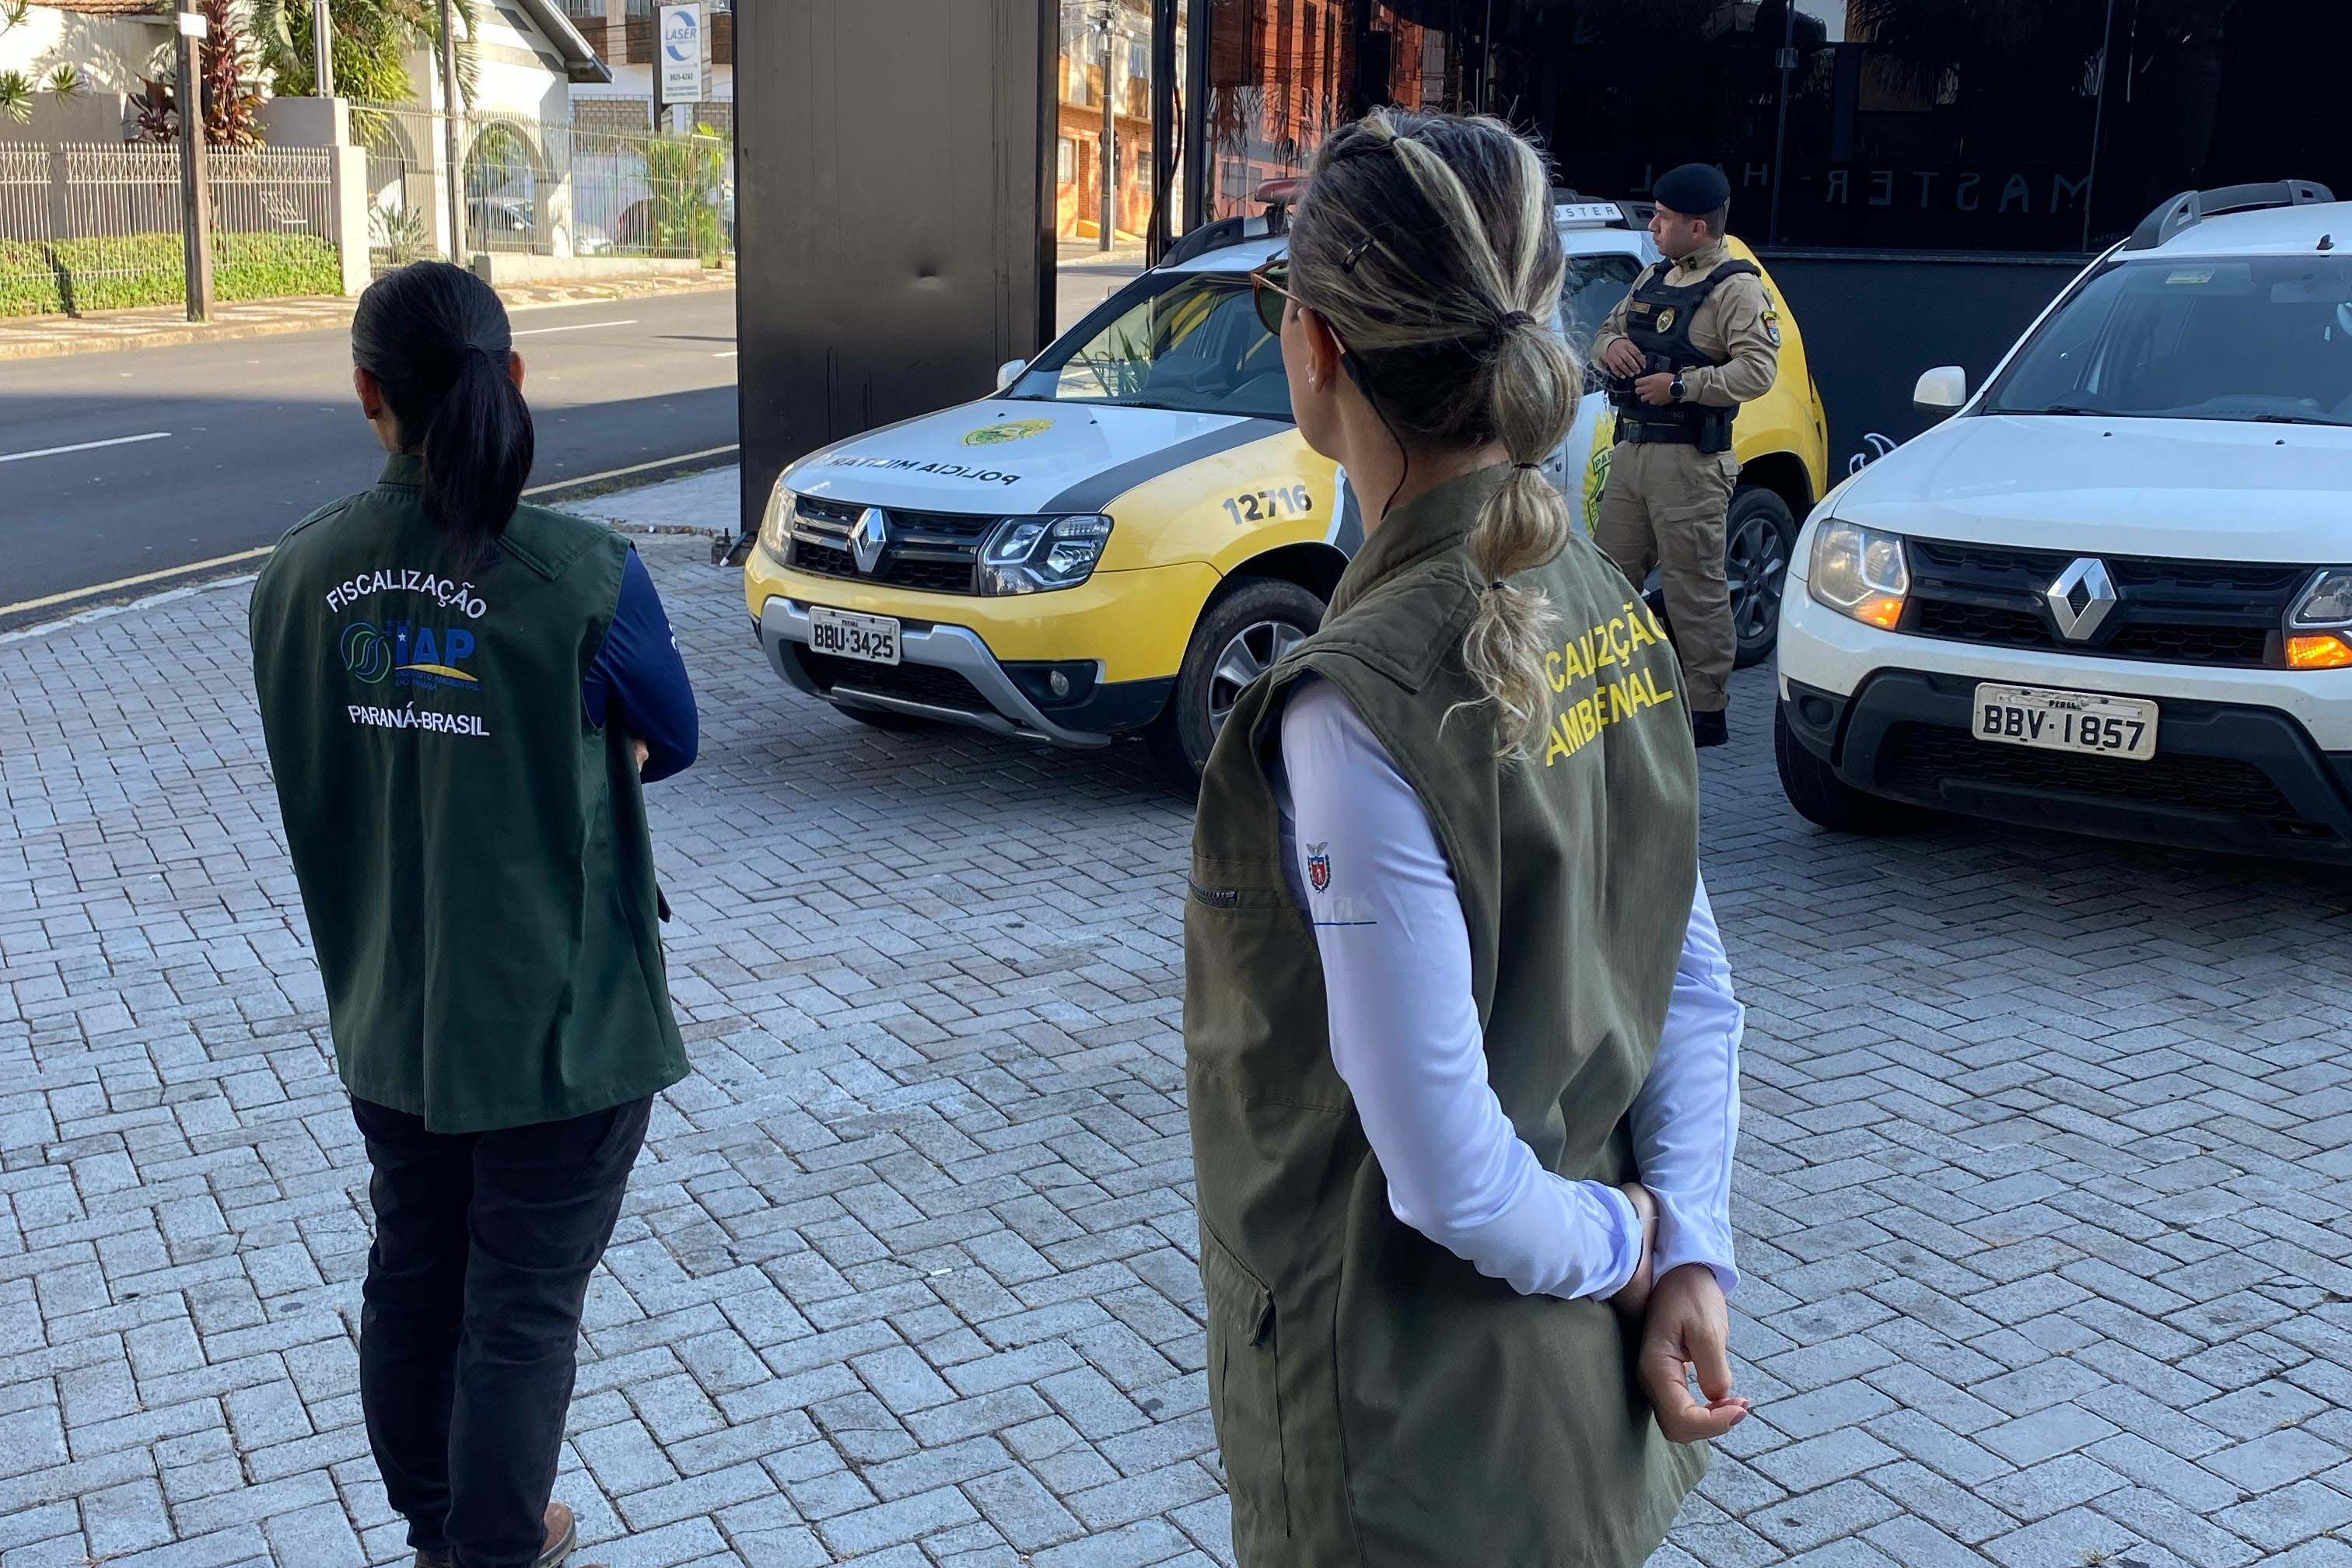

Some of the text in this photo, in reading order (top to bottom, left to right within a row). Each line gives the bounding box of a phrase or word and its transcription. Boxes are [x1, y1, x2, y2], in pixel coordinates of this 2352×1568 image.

[666, 28, 697, 40] LASER
[1556, 205, 1615, 219] STER
[1223, 485, 1312, 525] 12716
[326, 569, 488, 619] FISCALIZAÇÃO
[395, 625, 476, 667] IAP
[348, 701, 490, 737] PARANÁ-BRASIL
